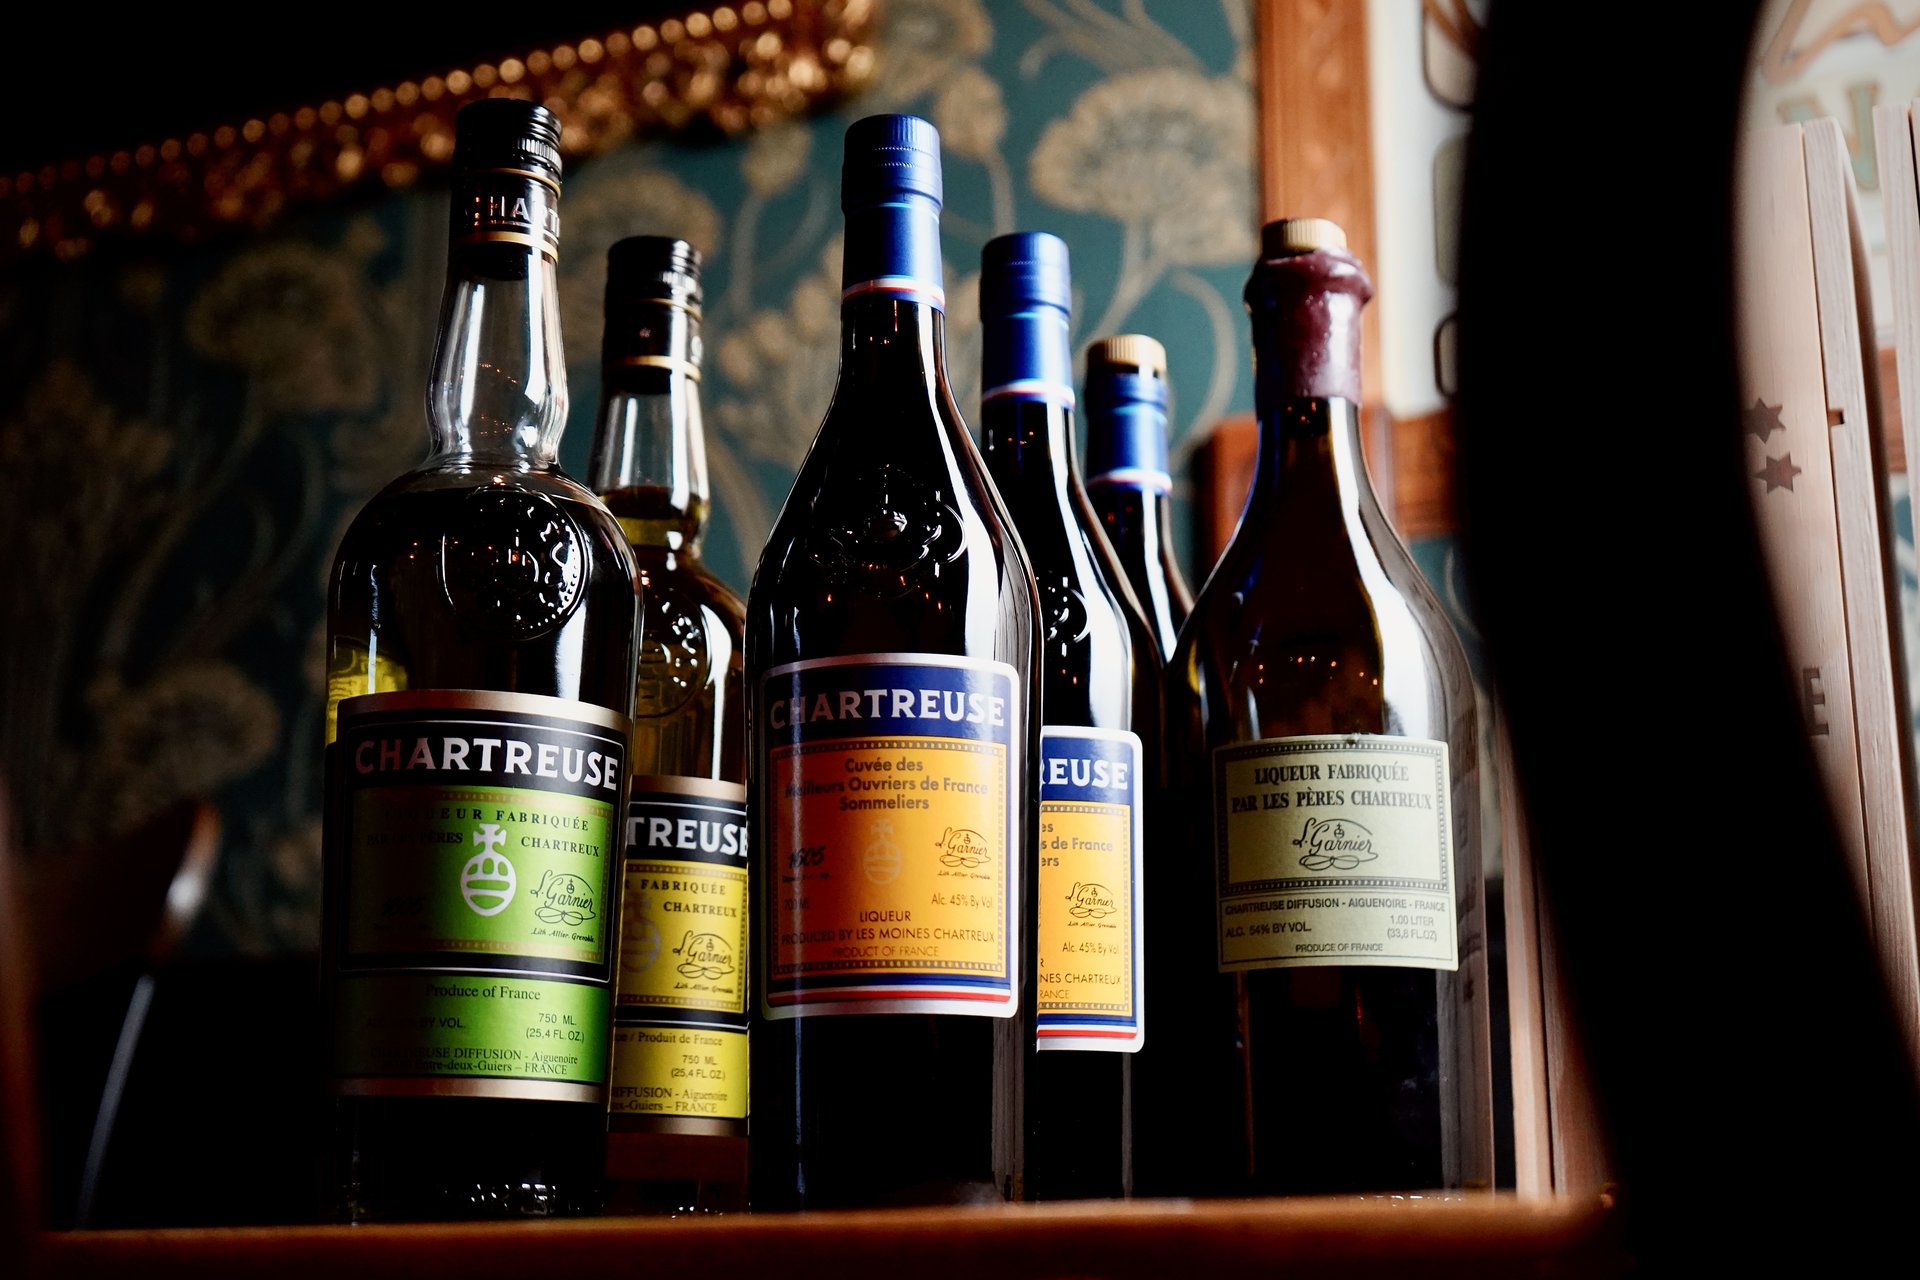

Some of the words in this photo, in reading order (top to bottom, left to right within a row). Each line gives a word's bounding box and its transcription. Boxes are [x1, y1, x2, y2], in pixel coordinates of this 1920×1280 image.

[769, 688, 1005, 730] CHARTREUSE
[354, 736, 619, 791] CHARTREUSE
[844, 757, 892, 773] Cuvée
[896, 756, 924, 772] des
[1254, 764, 1321, 784] LIQUEUR
[1327, 761, 1409, 783] FABRIQUÉE
[848, 777, 916, 793] Ouvriers
[920, 775, 939, 791] de
[943, 777, 989, 795] France
[839, 794, 930, 812] Sommeliers
[1232, 795, 1258, 813] PAR
[1262, 793, 1290, 810] LES
[1296, 786, 1345, 808] PÈRES
[1350, 790, 1433, 810] CHARTREUX
[496, 810, 590, 831] FABRIQUÉE
[520, 836, 601, 857] CHARTREUX
[1051, 836, 1068, 850] de
[1072, 837, 1113, 852] France
[640, 880, 726, 895] FABRIQUÉE
[663, 901, 738, 918] CHARTREUX
[1224, 901, 1286, 915] CHARTREUSE
[1286, 898, 1340, 910] DIFFUSION
[1347, 898, 1407, 909] AIGUENOIRE
[1414, 901, 1446, 912] FRANCE
[860, 911, 911, 922] LIQUEUR
[1410, 915, 1434, 926] LITER
[839, 929, 853, 941] BY
[856, 928, 875, 940] LES
[878, 928, 930, 940] MOINES
[933, 929, 995, 943] CHARTREUX
[1225, 925, 1245, 938] ALC.
[1249, 923, 1270, 936] 54%
[1271, 922, 1287, 934] BY
[1288, 921, 1312, 933] VOL.
[833, 946, 879, 958] PRODUCT
[882, 946, 896, 957] OF
[899, 946, 939, 958] FRANCE
[1295, 943, 1336, 953] PRODUCE
[1337, 943, 1349, 952] OF
[1350, 942, 1384, 952] FRANCE
[1064, 973, 1122, 985] CHARTREUX
[425, 983, 479, 998] Produce
[482, 983, 496, 997] of
[499, 985, 541, 1000] France
[440, 1016, 466, 1028] VOL.
[538, 1012, 557, 1024] 750
[638, 1031, 677, 1043] Produit
[679, 1033, 691, 1044] de
[693, 1035, 723, 1046] France
[453, 1048, 522, 1060] DIFFUSION
[531, 1051, 578, 1066] Aiguenoire
[524, 1062, 568, 1075] FRANCE
[675, 1101, 718, 1113] FRANCE
